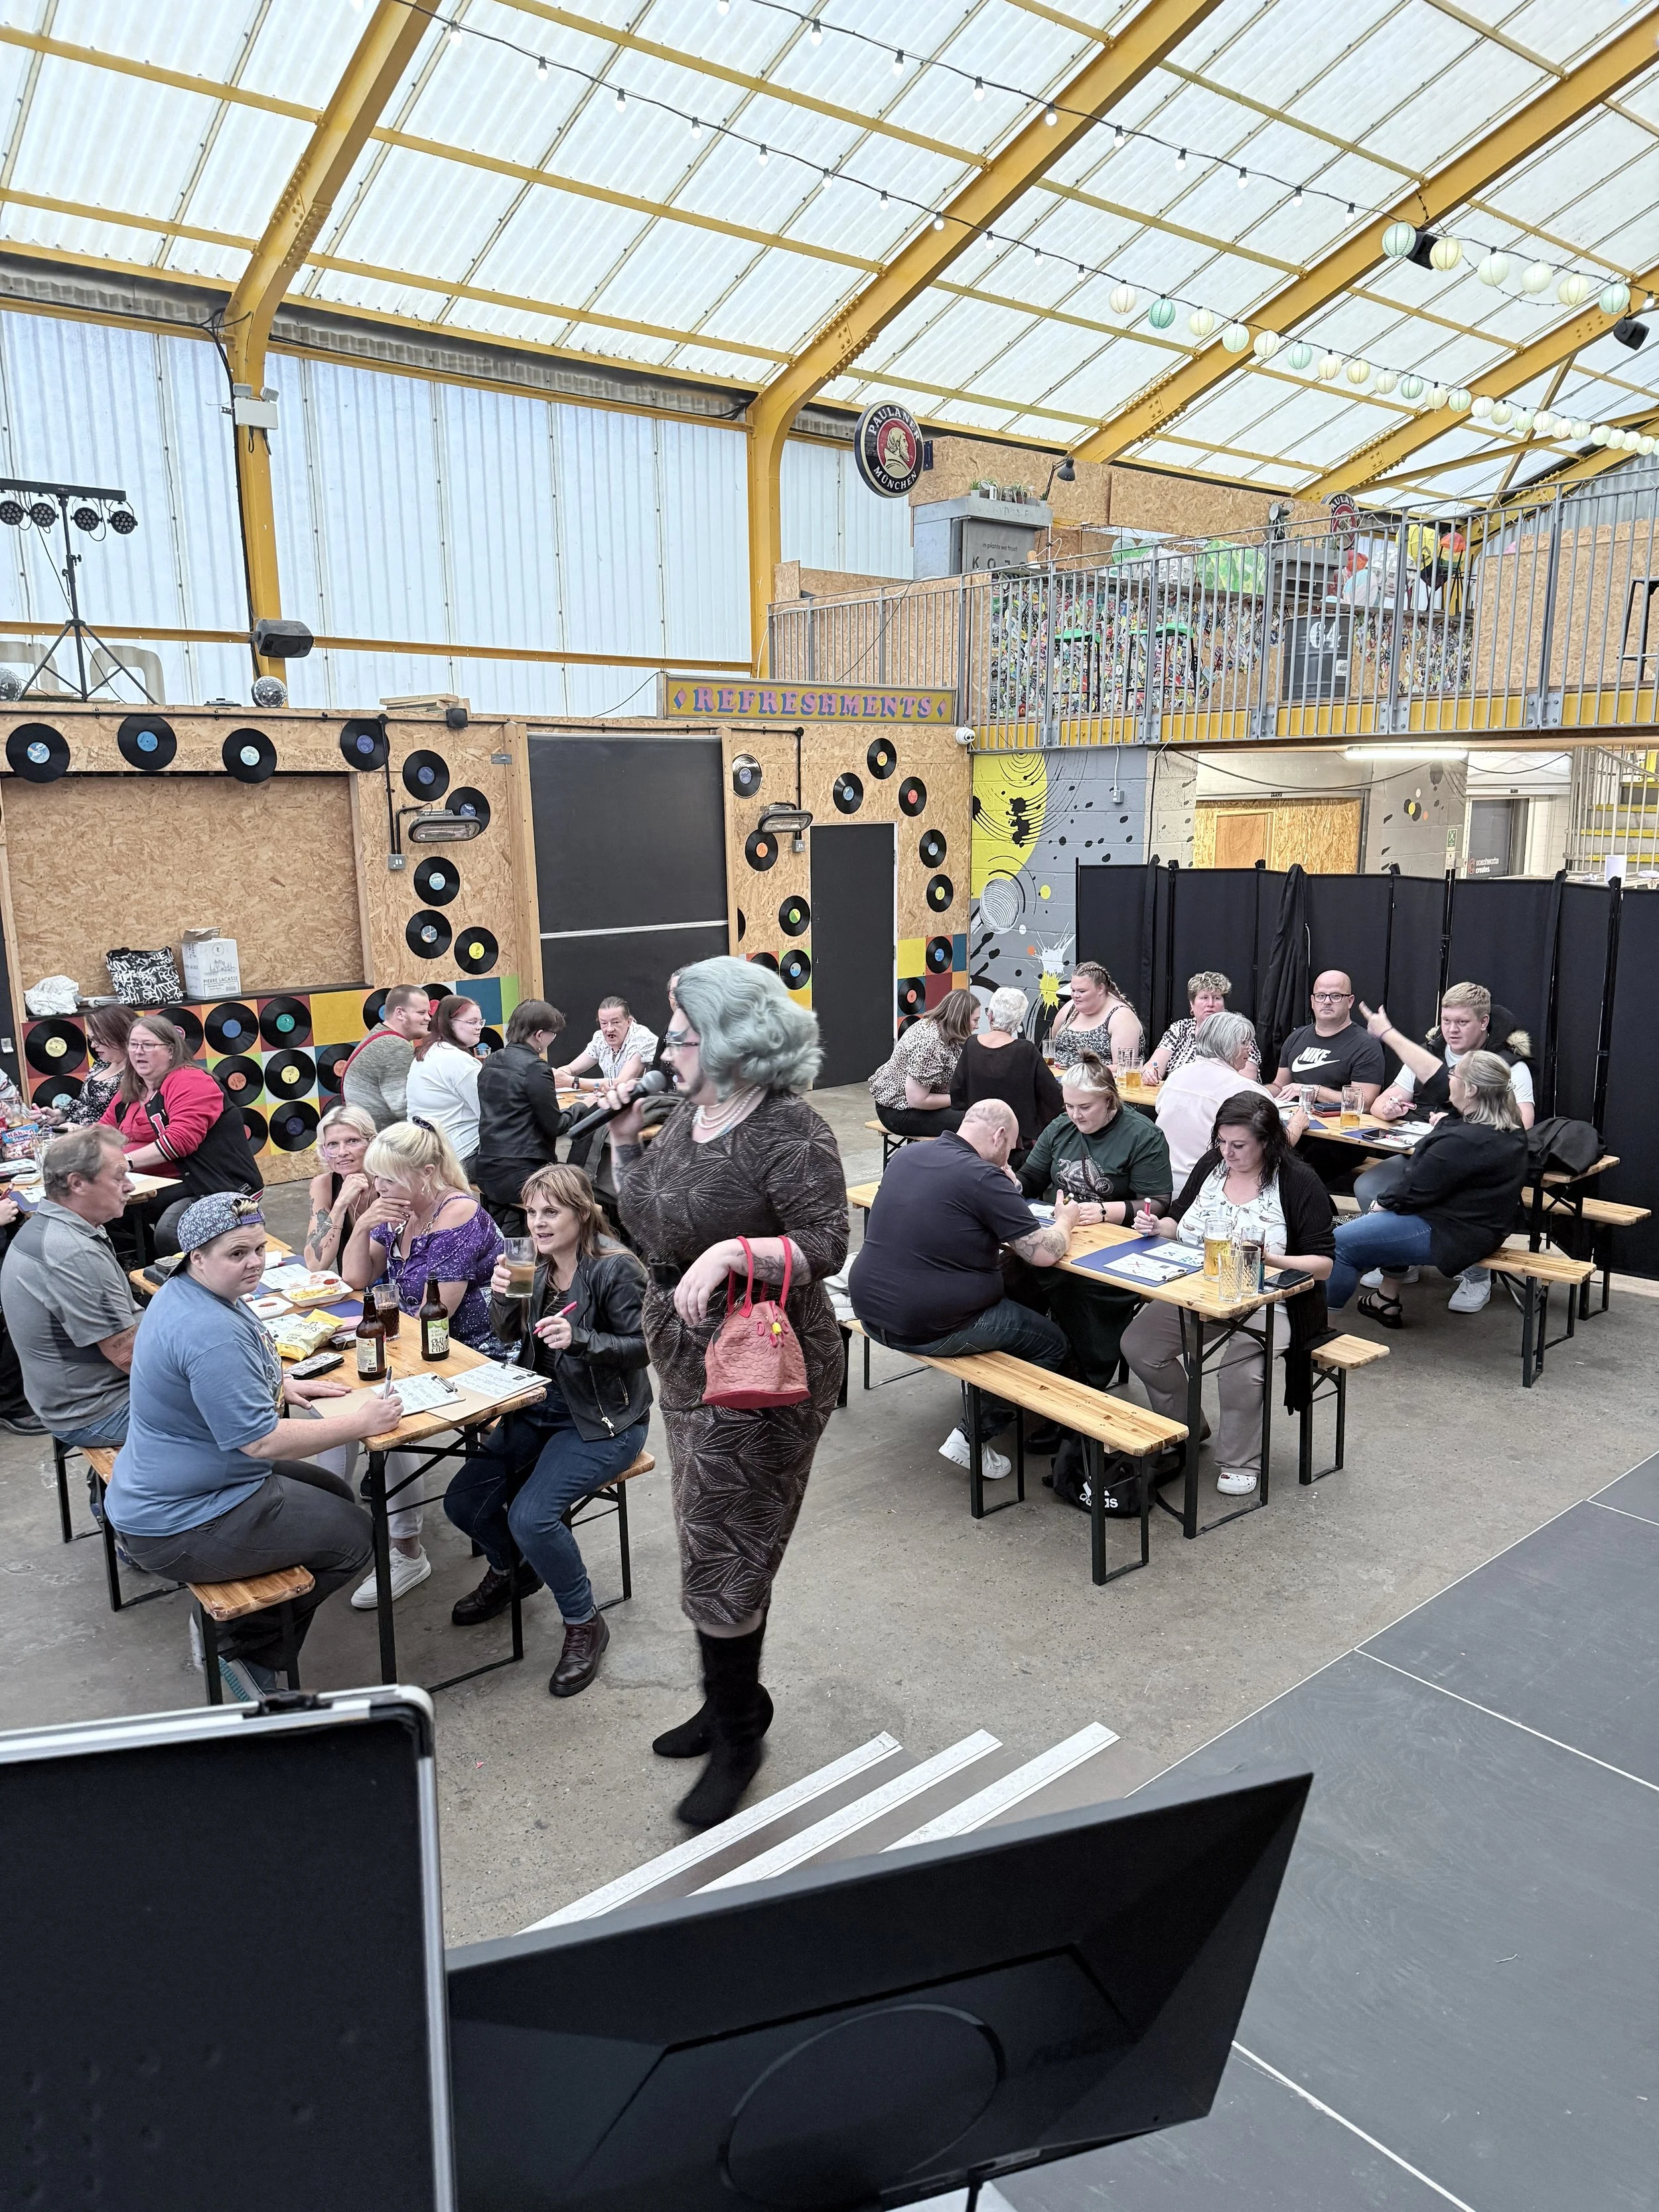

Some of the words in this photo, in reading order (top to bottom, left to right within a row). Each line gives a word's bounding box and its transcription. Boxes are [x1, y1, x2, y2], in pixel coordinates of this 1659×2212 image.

[868, 407, 920, 441] PAULANER
[873, 466, 917, 490] MÜNCHEN
[1310, 621, 1342, 648] 64
[693, 686, 932, 718] REFRESHMENTS
[1299, 1046, 1331, 1063] NIKE
